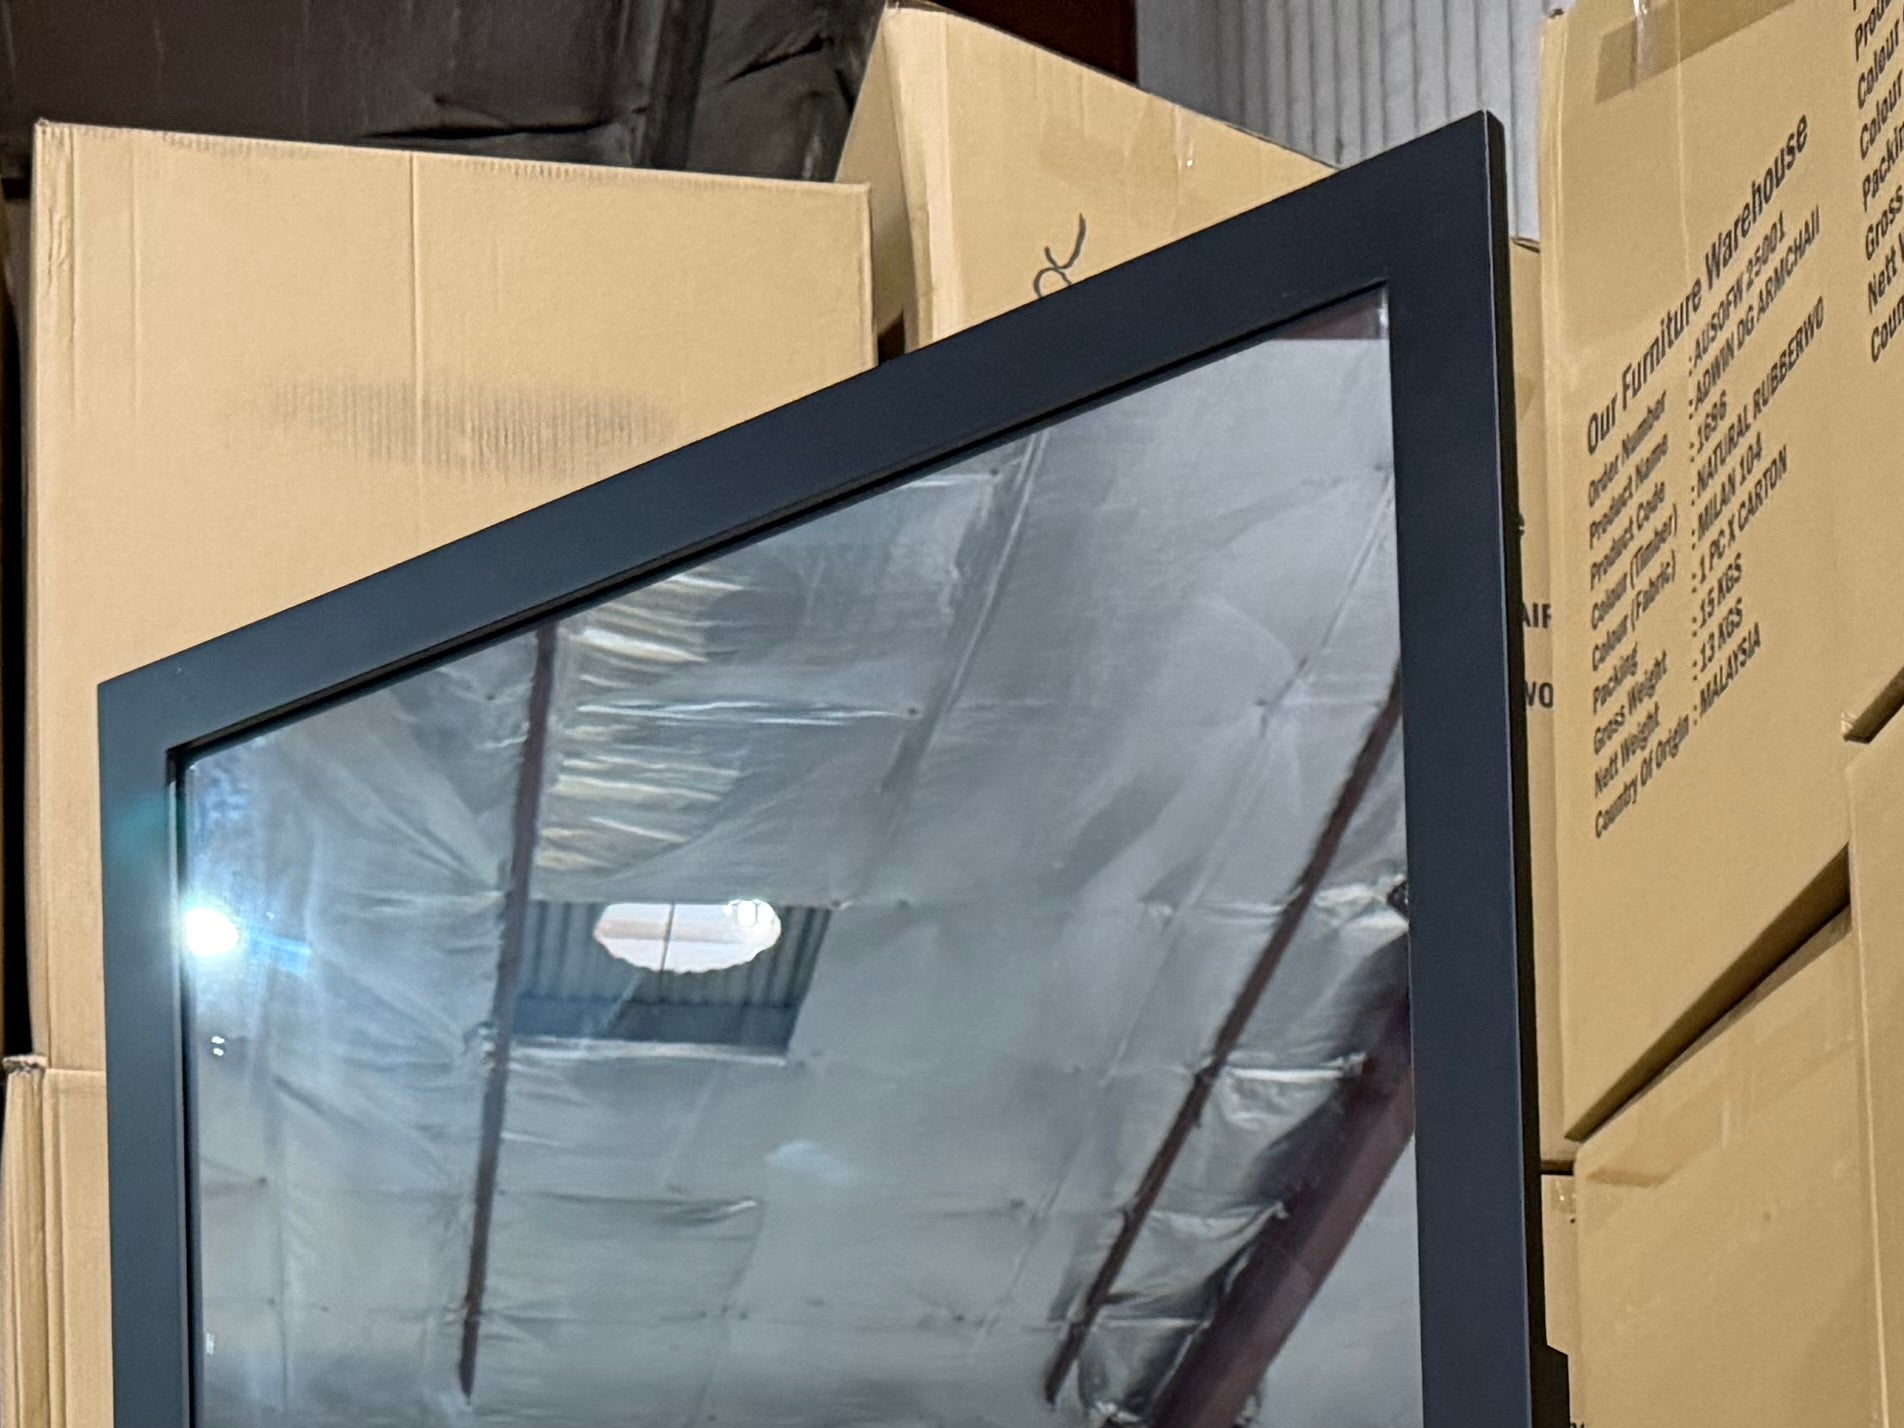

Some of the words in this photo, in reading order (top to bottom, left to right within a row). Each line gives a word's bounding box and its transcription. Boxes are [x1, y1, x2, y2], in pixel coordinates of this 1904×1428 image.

[1587, 394, 1618, 456] Our
[1621, 278, 1702, 411] Furniture
[1705, 114, 1807, 290] Warehouse
[1694, 272, 1743, 368] AUSOFW
[1746, 210, 1786, 288] 25001
[1868, 252, 1898, 314] Nett
[1697, 473, 1737, 542] MILAN
[1740, 432, 1762, 485] 104
